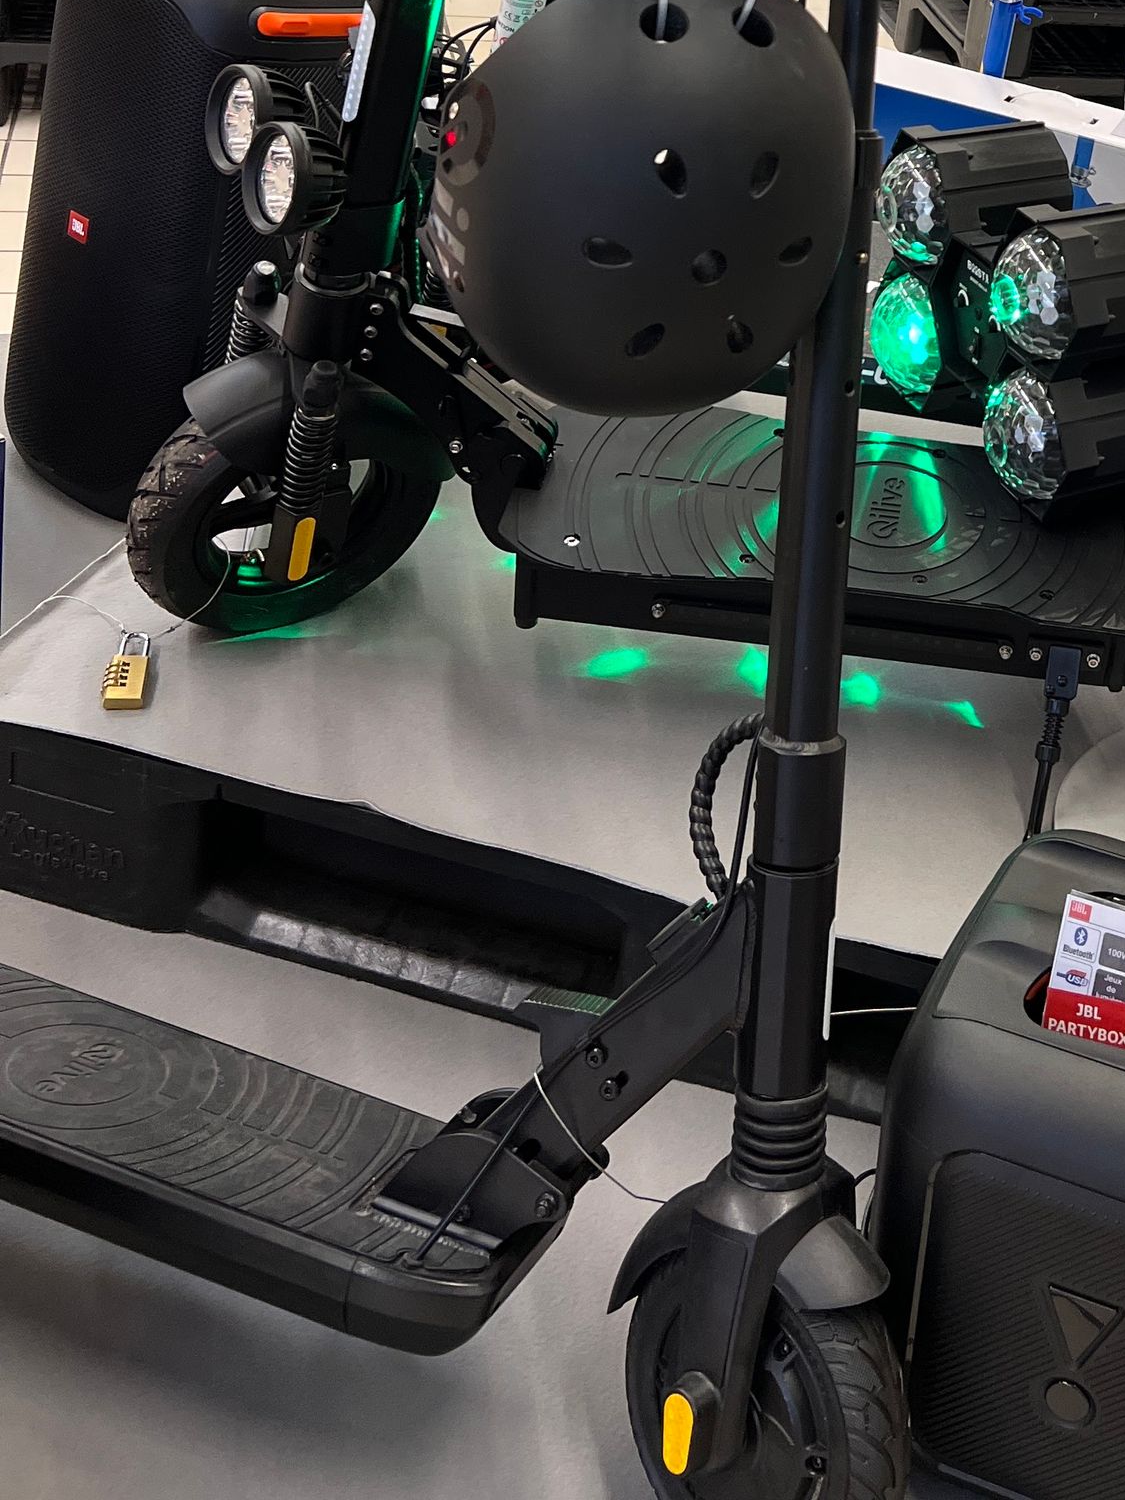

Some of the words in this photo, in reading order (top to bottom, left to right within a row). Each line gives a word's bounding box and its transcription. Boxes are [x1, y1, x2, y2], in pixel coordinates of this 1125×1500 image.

[866, 476, 905, 540] Qilive
[1071, 901, 1088, 915] JBL
[1063, 944, 1095, 960] Bluetooth
[1103, 974, 1123, 986] Jeux
[1105, 985, 1117, 994] de
[1075, 1003, 1102, 1021] JBL
